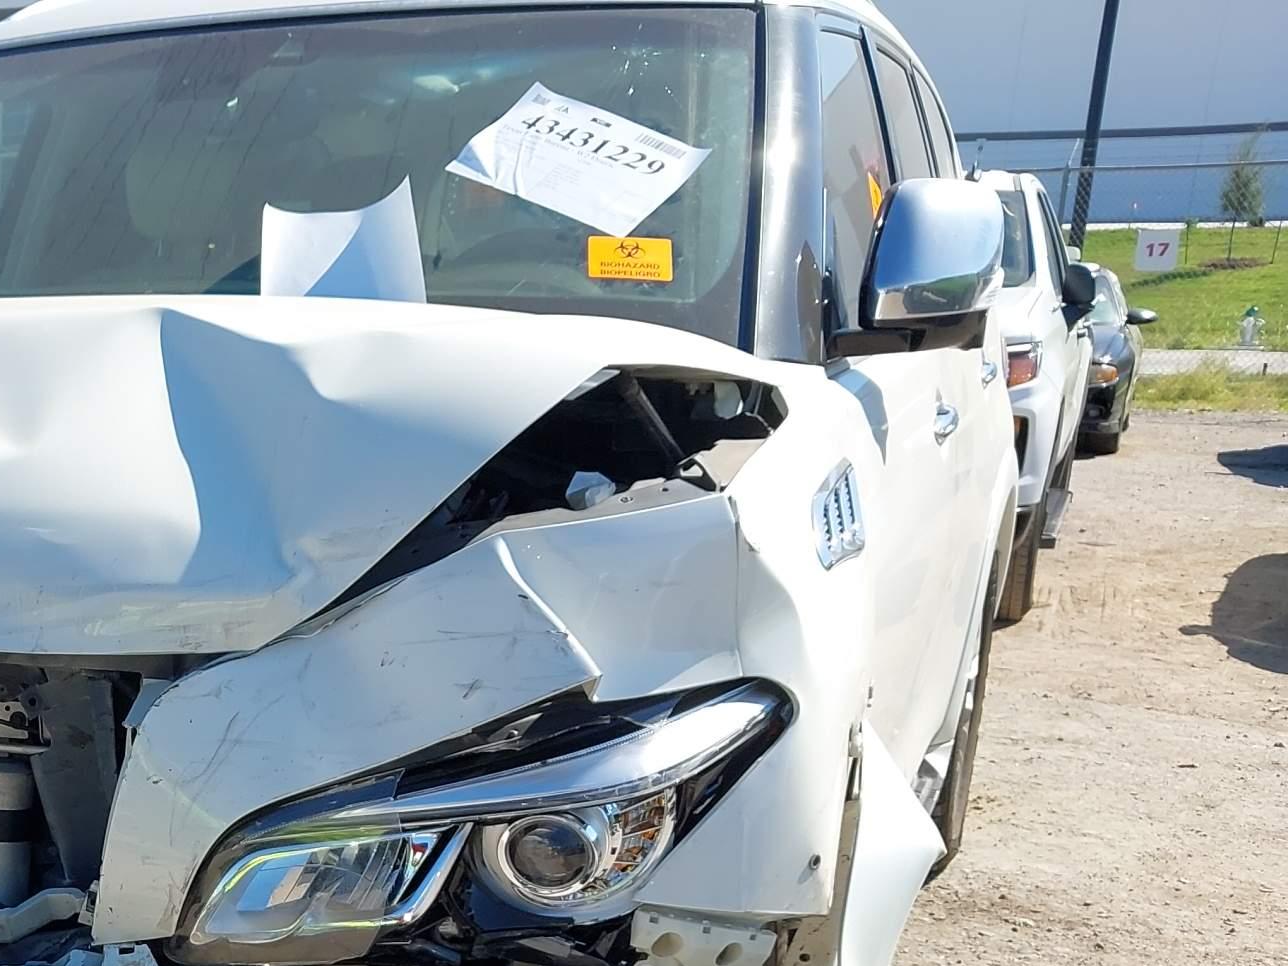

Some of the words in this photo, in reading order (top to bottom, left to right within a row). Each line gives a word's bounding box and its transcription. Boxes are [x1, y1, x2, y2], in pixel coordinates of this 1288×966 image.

[522, 115, 665, 175] 43431229
[1146, 242, 1170, 257] 17
[600, 261, 660, 269] BIOHAZARD
[600, 269, 661, 278] BIOPELIGRO
